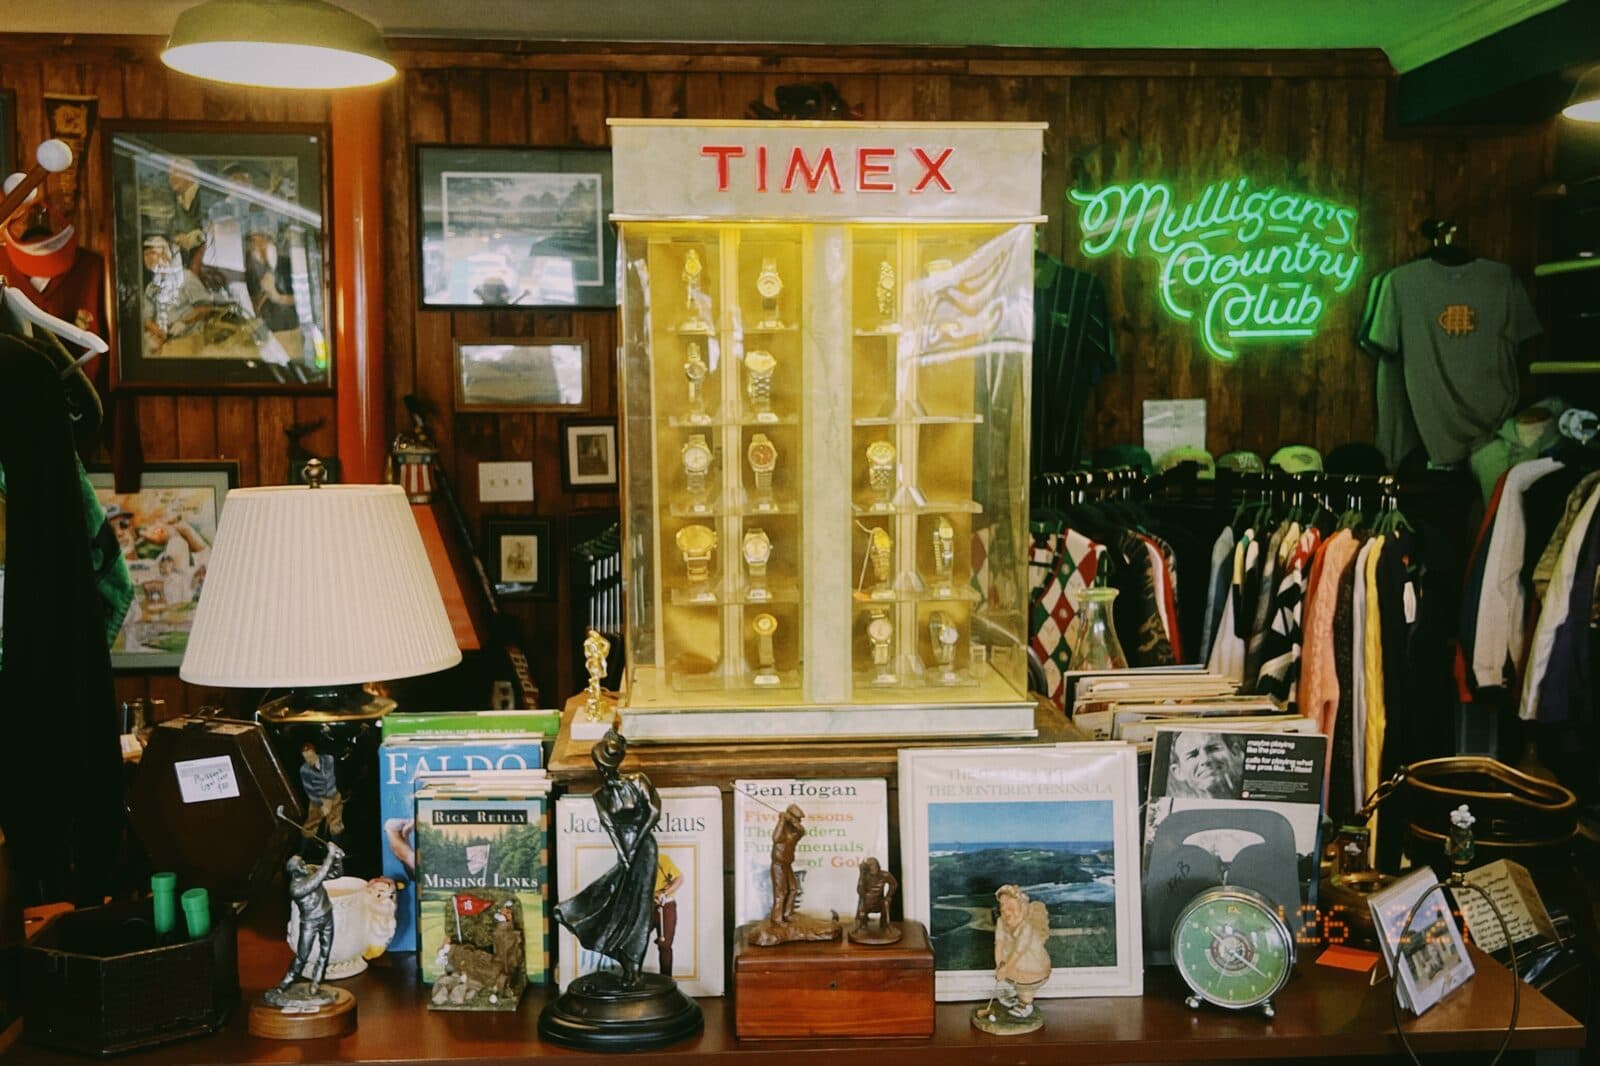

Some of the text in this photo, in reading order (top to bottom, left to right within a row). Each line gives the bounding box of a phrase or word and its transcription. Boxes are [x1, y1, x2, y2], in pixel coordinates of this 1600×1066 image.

[700, 145, 956, 194] TIMEX
[1069, 178, 1355, 254] Mulligan's
[1162, 232, 1360, 319] Country
[1204, 282, 1323, 358] Club
[744, 783, 857, 798] Ben Hogan
[477, 811, 526, 823] REILLY
[831, 855, 861, 868] Gol
[424, 872, 538, 888] MISSING LINKS
